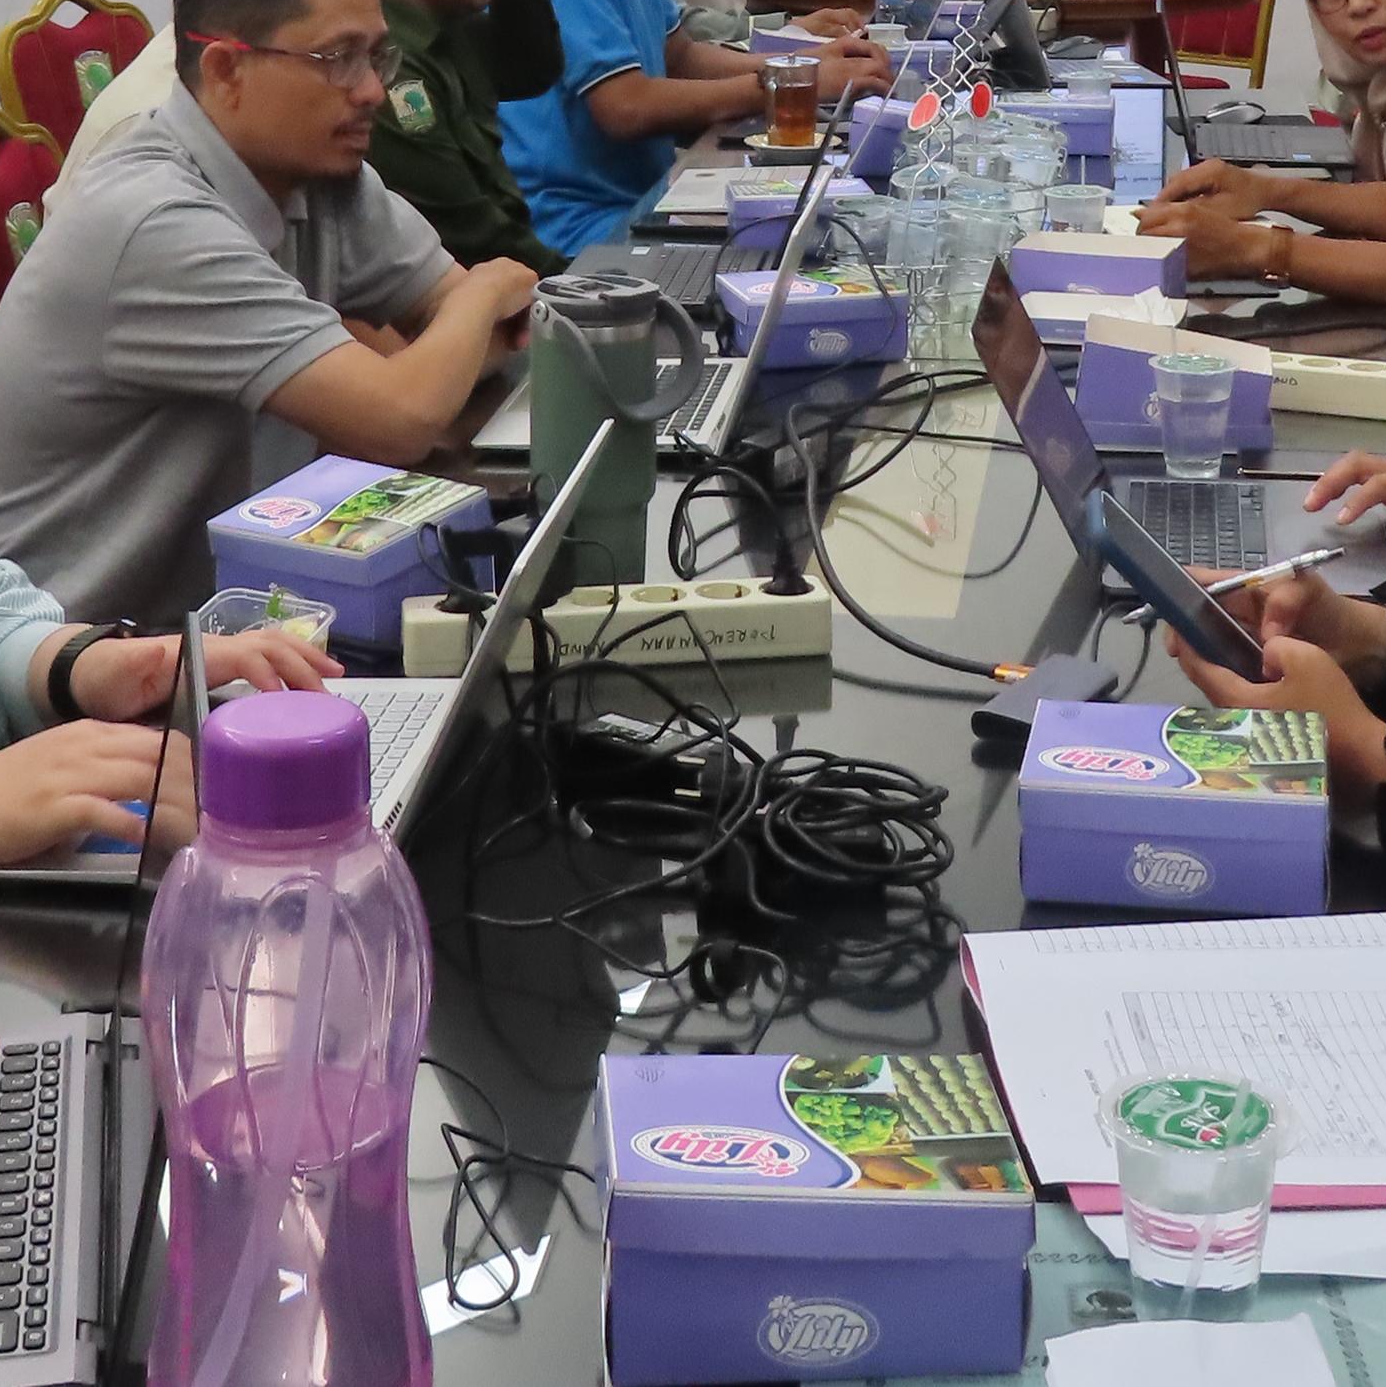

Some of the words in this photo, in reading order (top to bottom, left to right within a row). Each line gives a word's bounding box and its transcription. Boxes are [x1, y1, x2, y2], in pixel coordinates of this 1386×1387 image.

[1141, 857, 1205, 894] Lily
[655, 1128, 774, 1165] Lily
[771, 1313, 866, 1359] Lily
